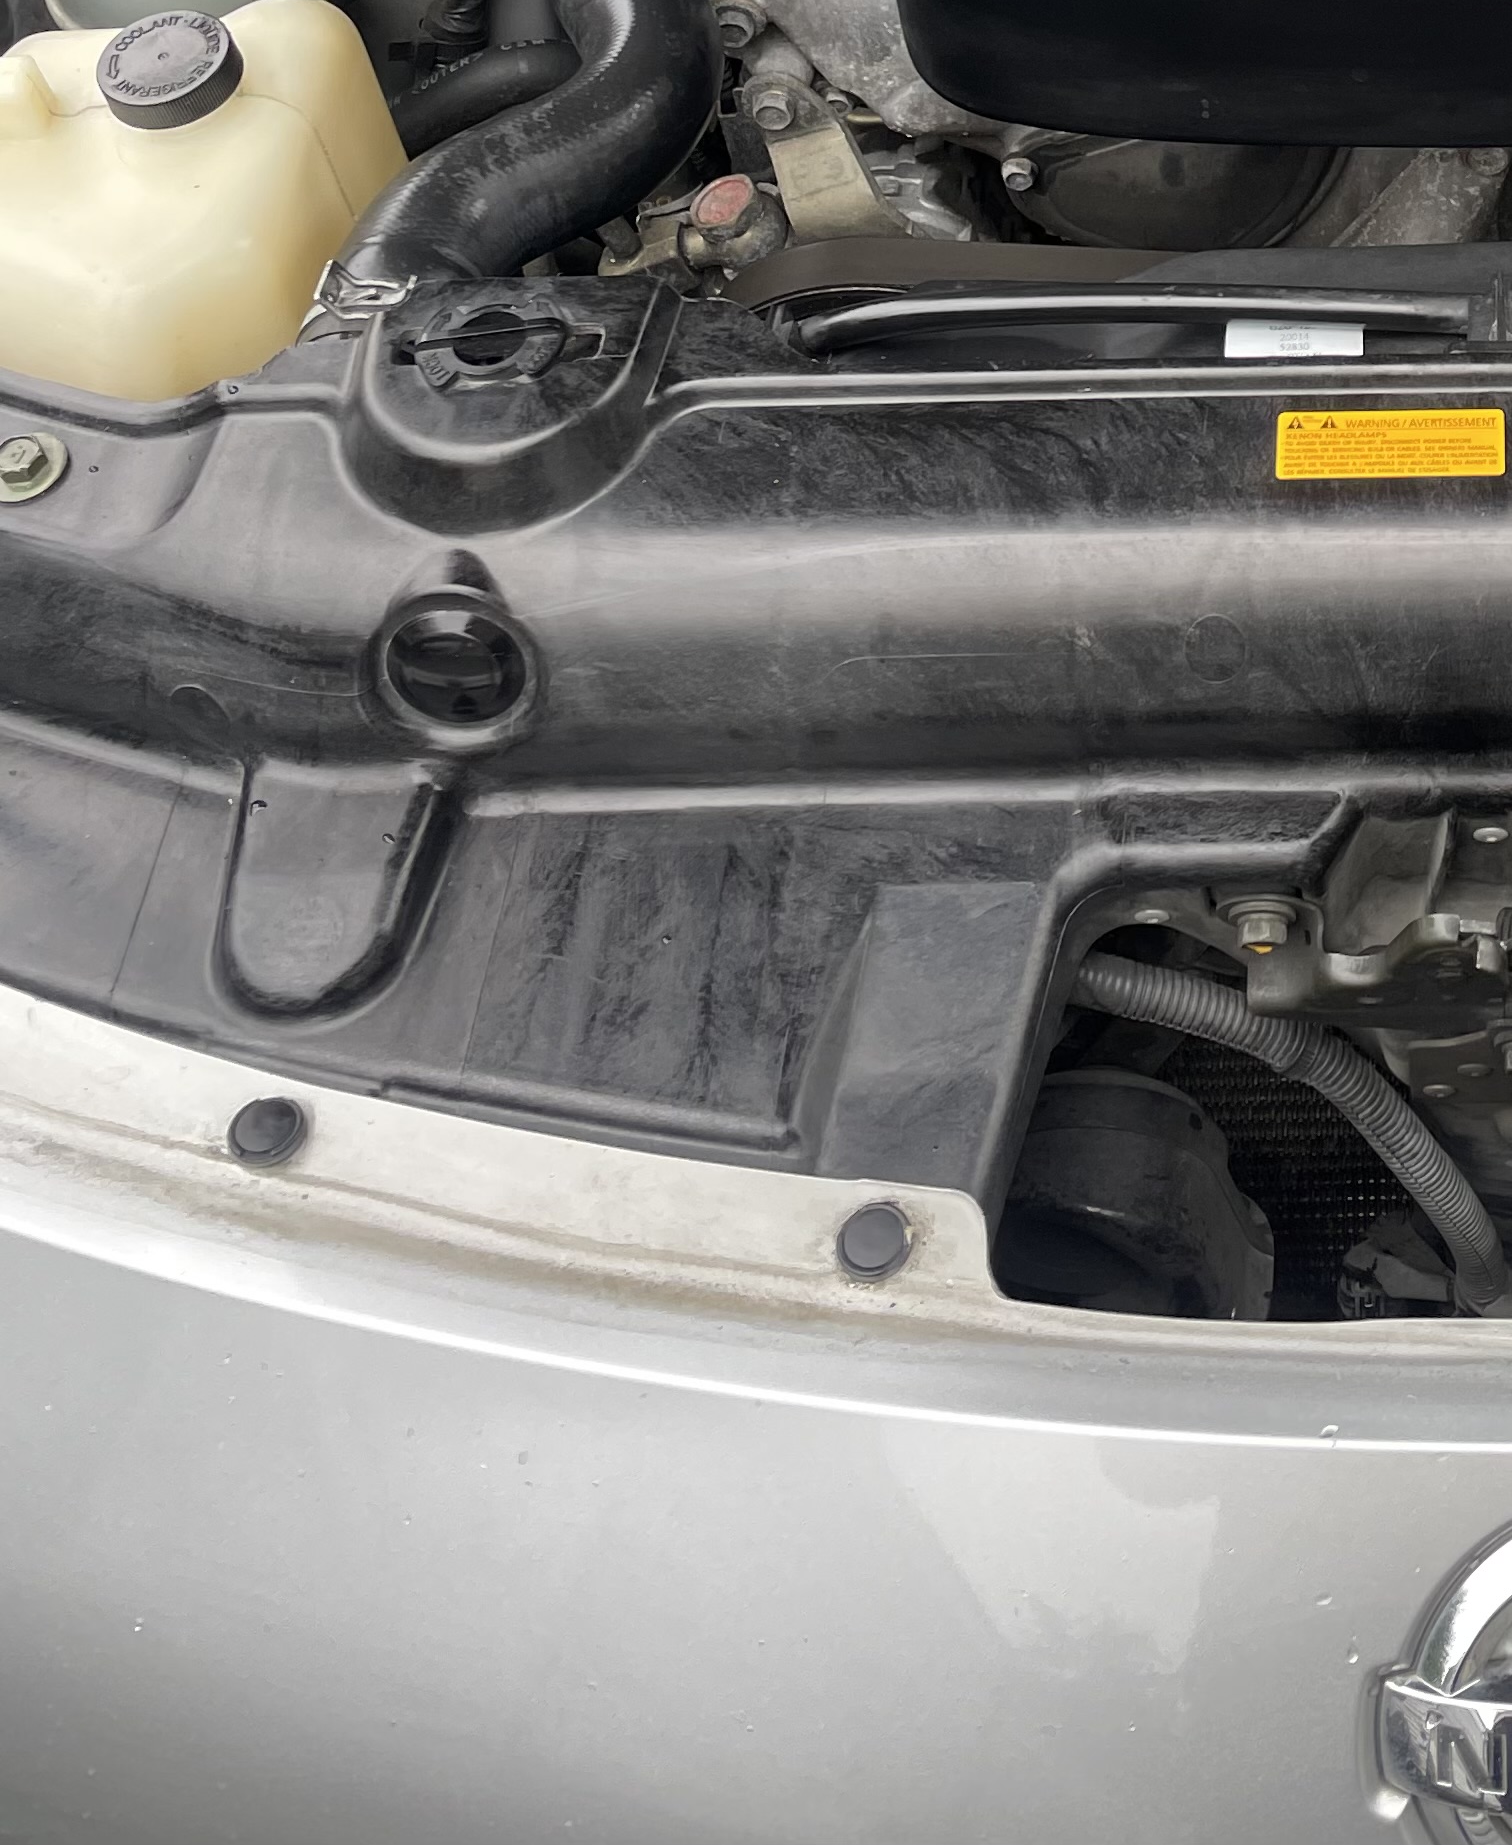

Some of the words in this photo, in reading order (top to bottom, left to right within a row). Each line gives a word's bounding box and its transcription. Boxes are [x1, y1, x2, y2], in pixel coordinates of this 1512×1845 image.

[115, 16, 183, 51] COOLANT
[1345, 419, 1400, 429] WARNING
[1409, 417, 1497, 428] AVERTISSEMENT
[1325, 431, 1387, 439] HEADLAMPS
